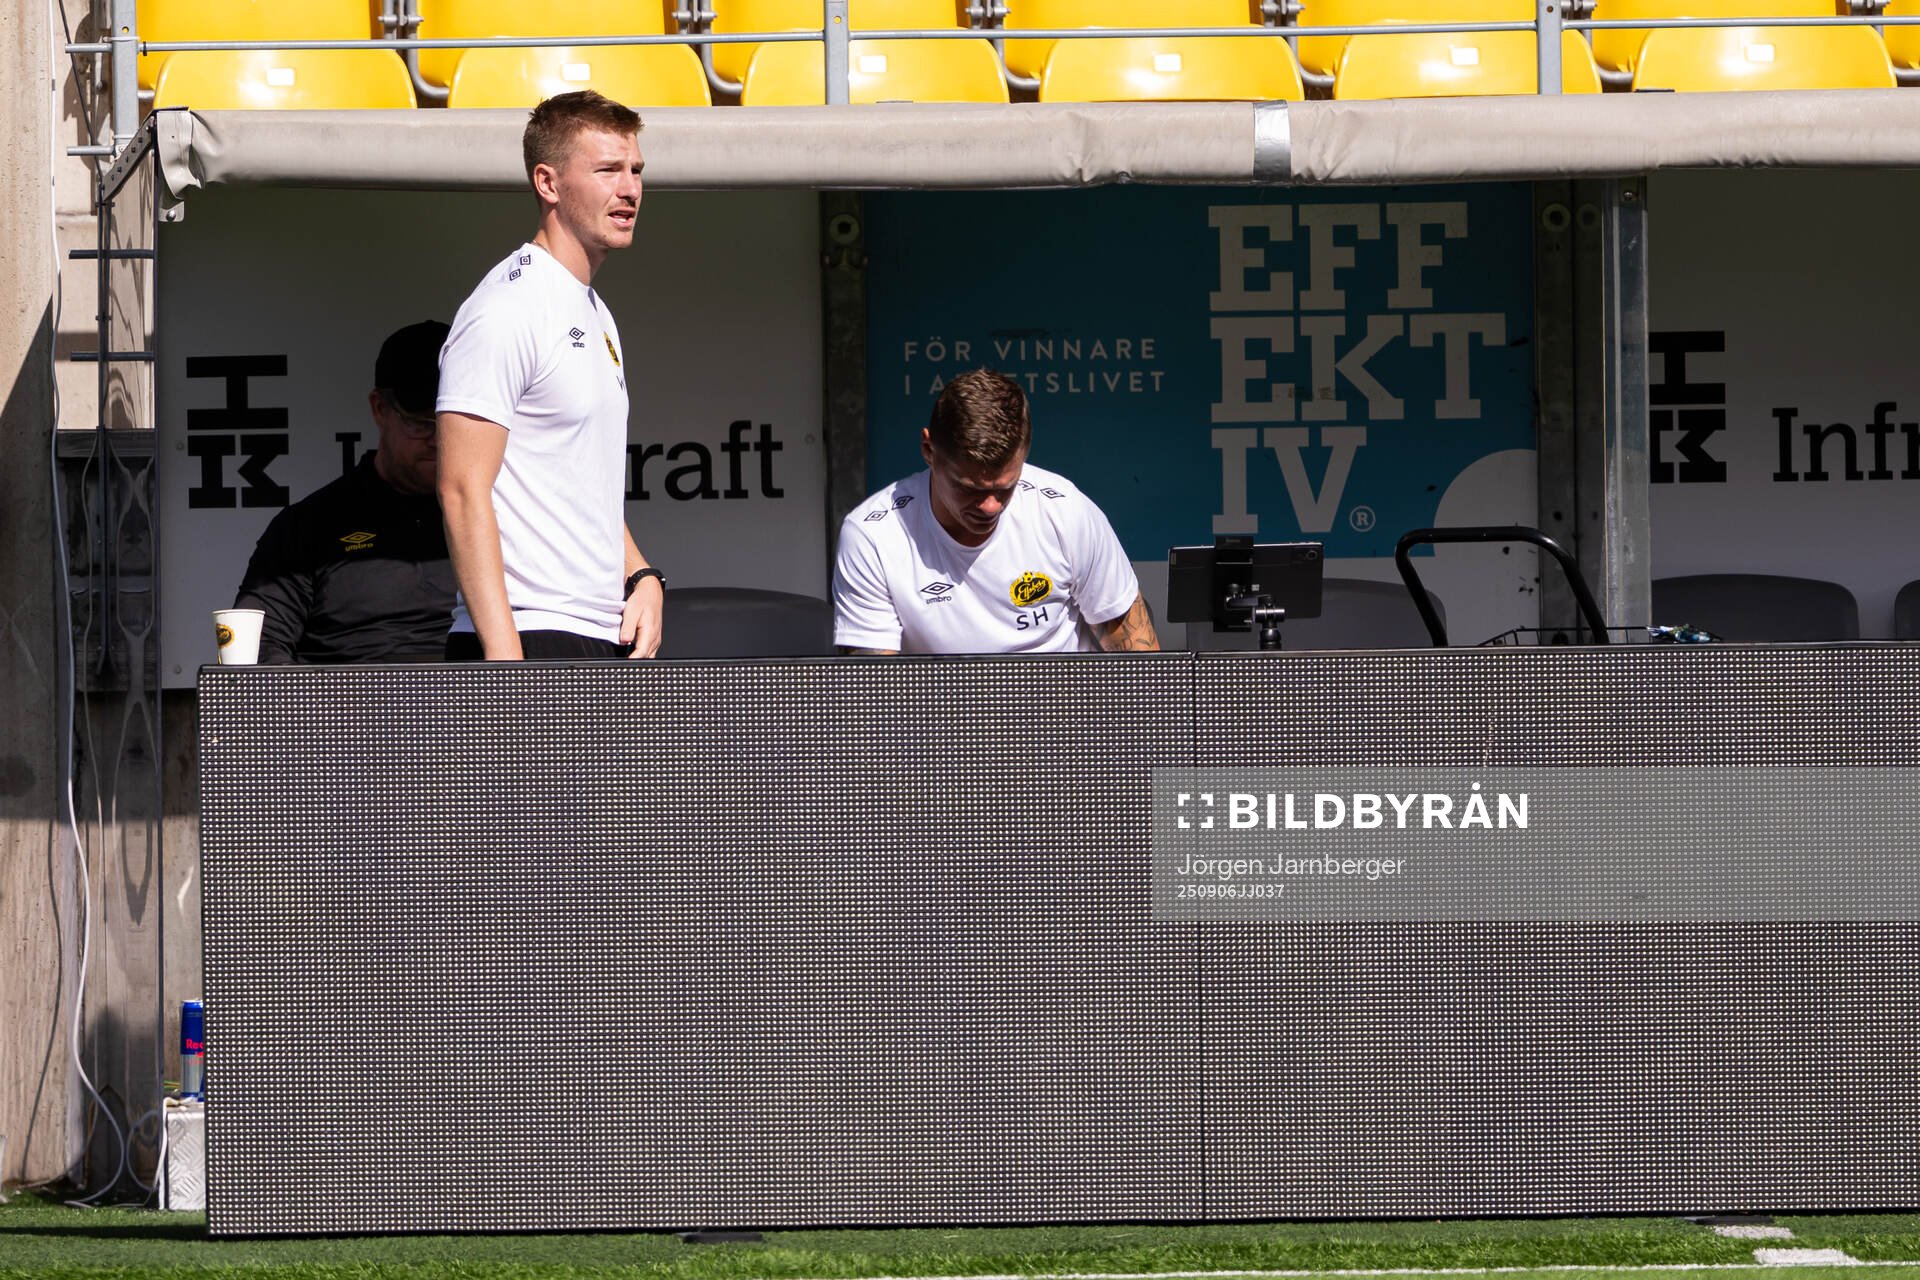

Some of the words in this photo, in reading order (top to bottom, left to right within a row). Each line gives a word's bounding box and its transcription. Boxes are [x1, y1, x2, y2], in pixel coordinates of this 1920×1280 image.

[904, 336, 971, 362] FÖR
[994, 338, 1155, 361] VINNARE
[904, 374, 911, 395] I
[929, 371, 1165, 395] ATSLIVET
[926, 595, 952, 604] umbro
